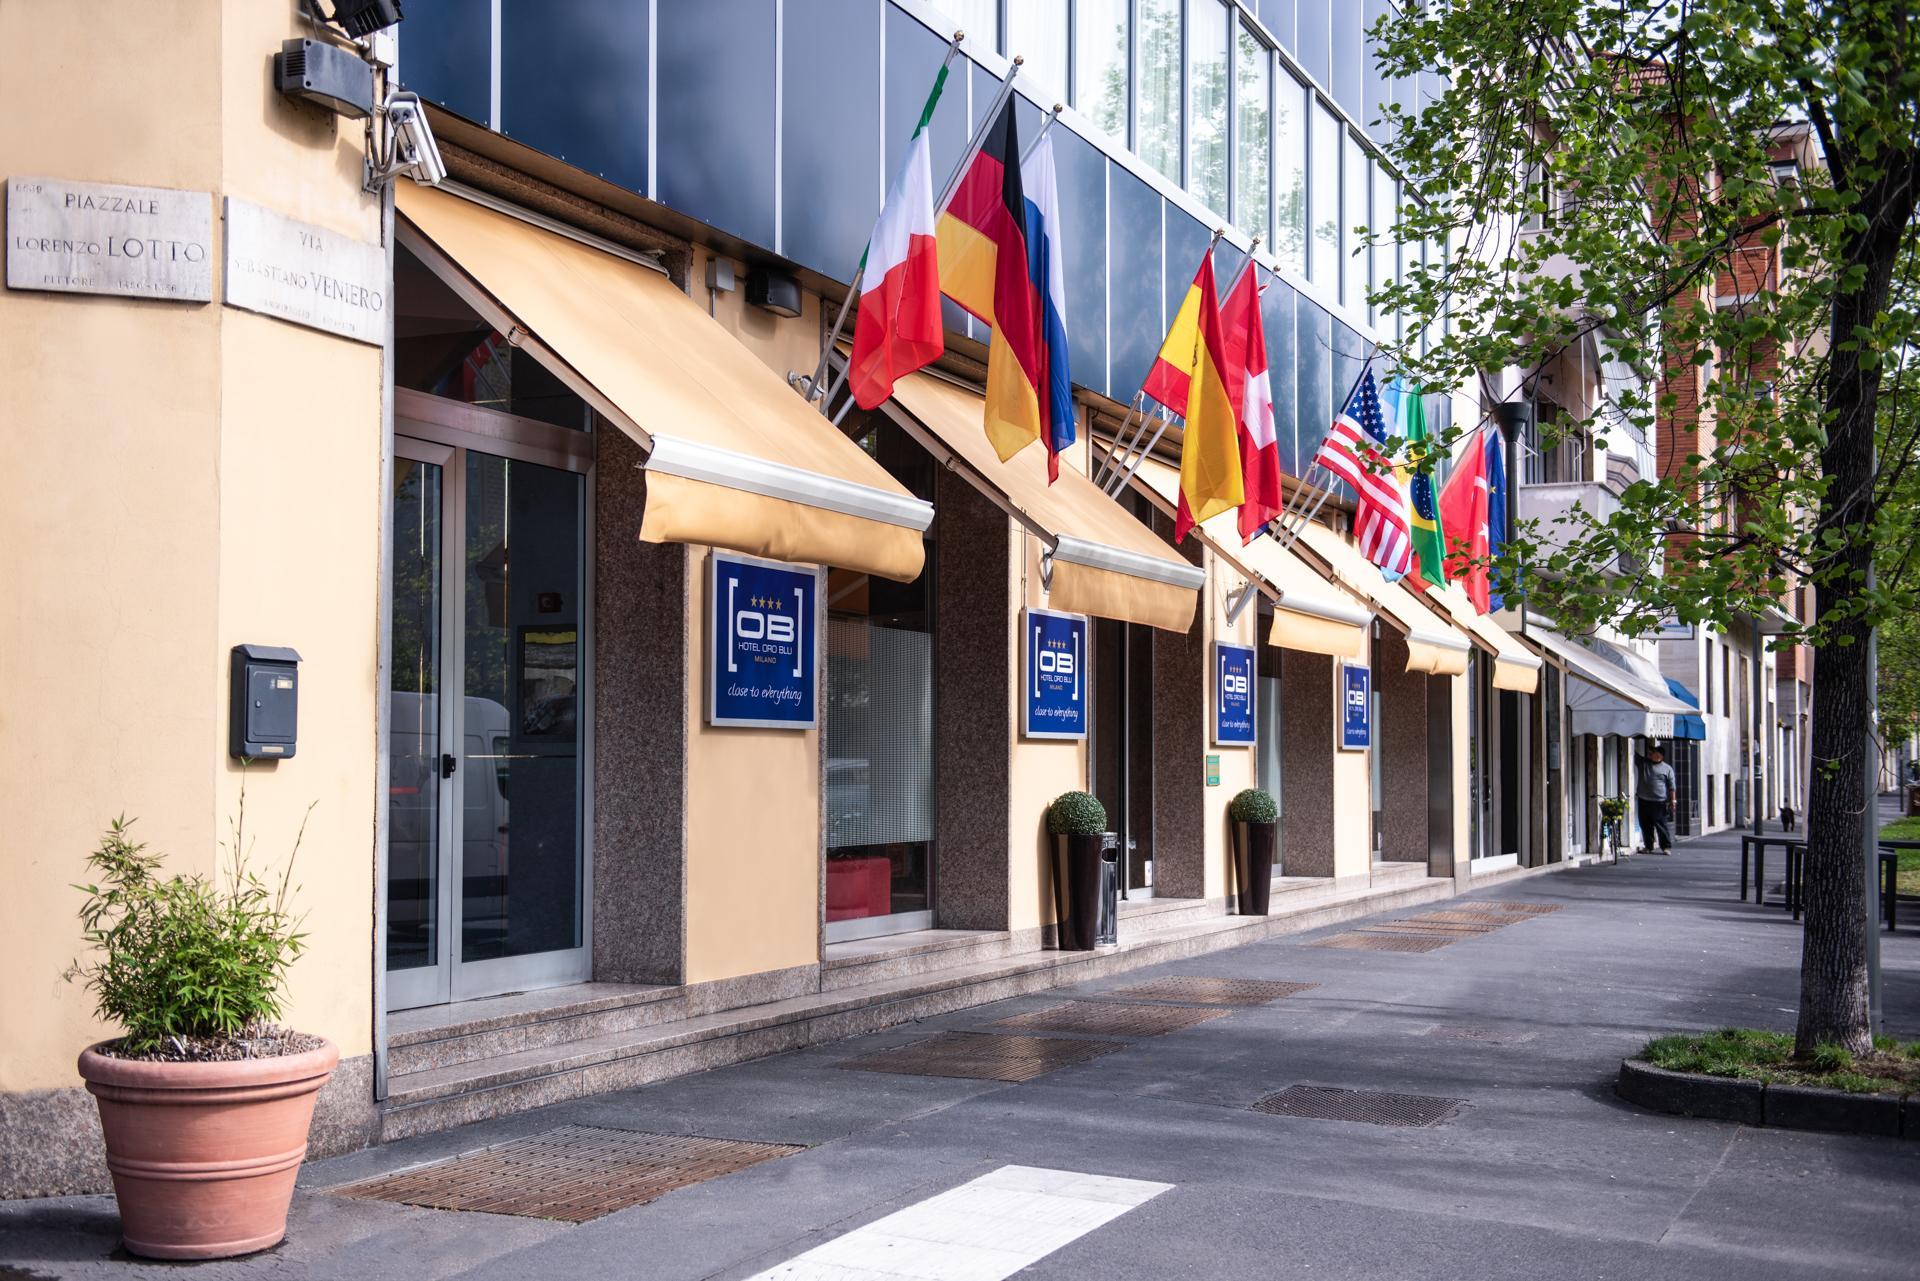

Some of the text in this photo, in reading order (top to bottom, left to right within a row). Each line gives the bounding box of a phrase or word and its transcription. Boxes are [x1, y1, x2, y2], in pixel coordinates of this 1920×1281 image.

[64, 193, 159, 215] PIAZZALE
[16, 236, 205, 263] LORENZO LOTTO
[300, 231, 323, 251] VIA
[310, 272, 383, 312] VENIERO
[736, 610, 794, 643] OB
[738, 641, 792, 655] HOTEL ORO BLU
[754, 655, 777, 664] MILANO
[1040, 650, 1073, 674] OB
[728, 683, 802, 706] close to everything
[1224, 674, 1247, 693] OB
[1349, 690, 1363, 705] OB
